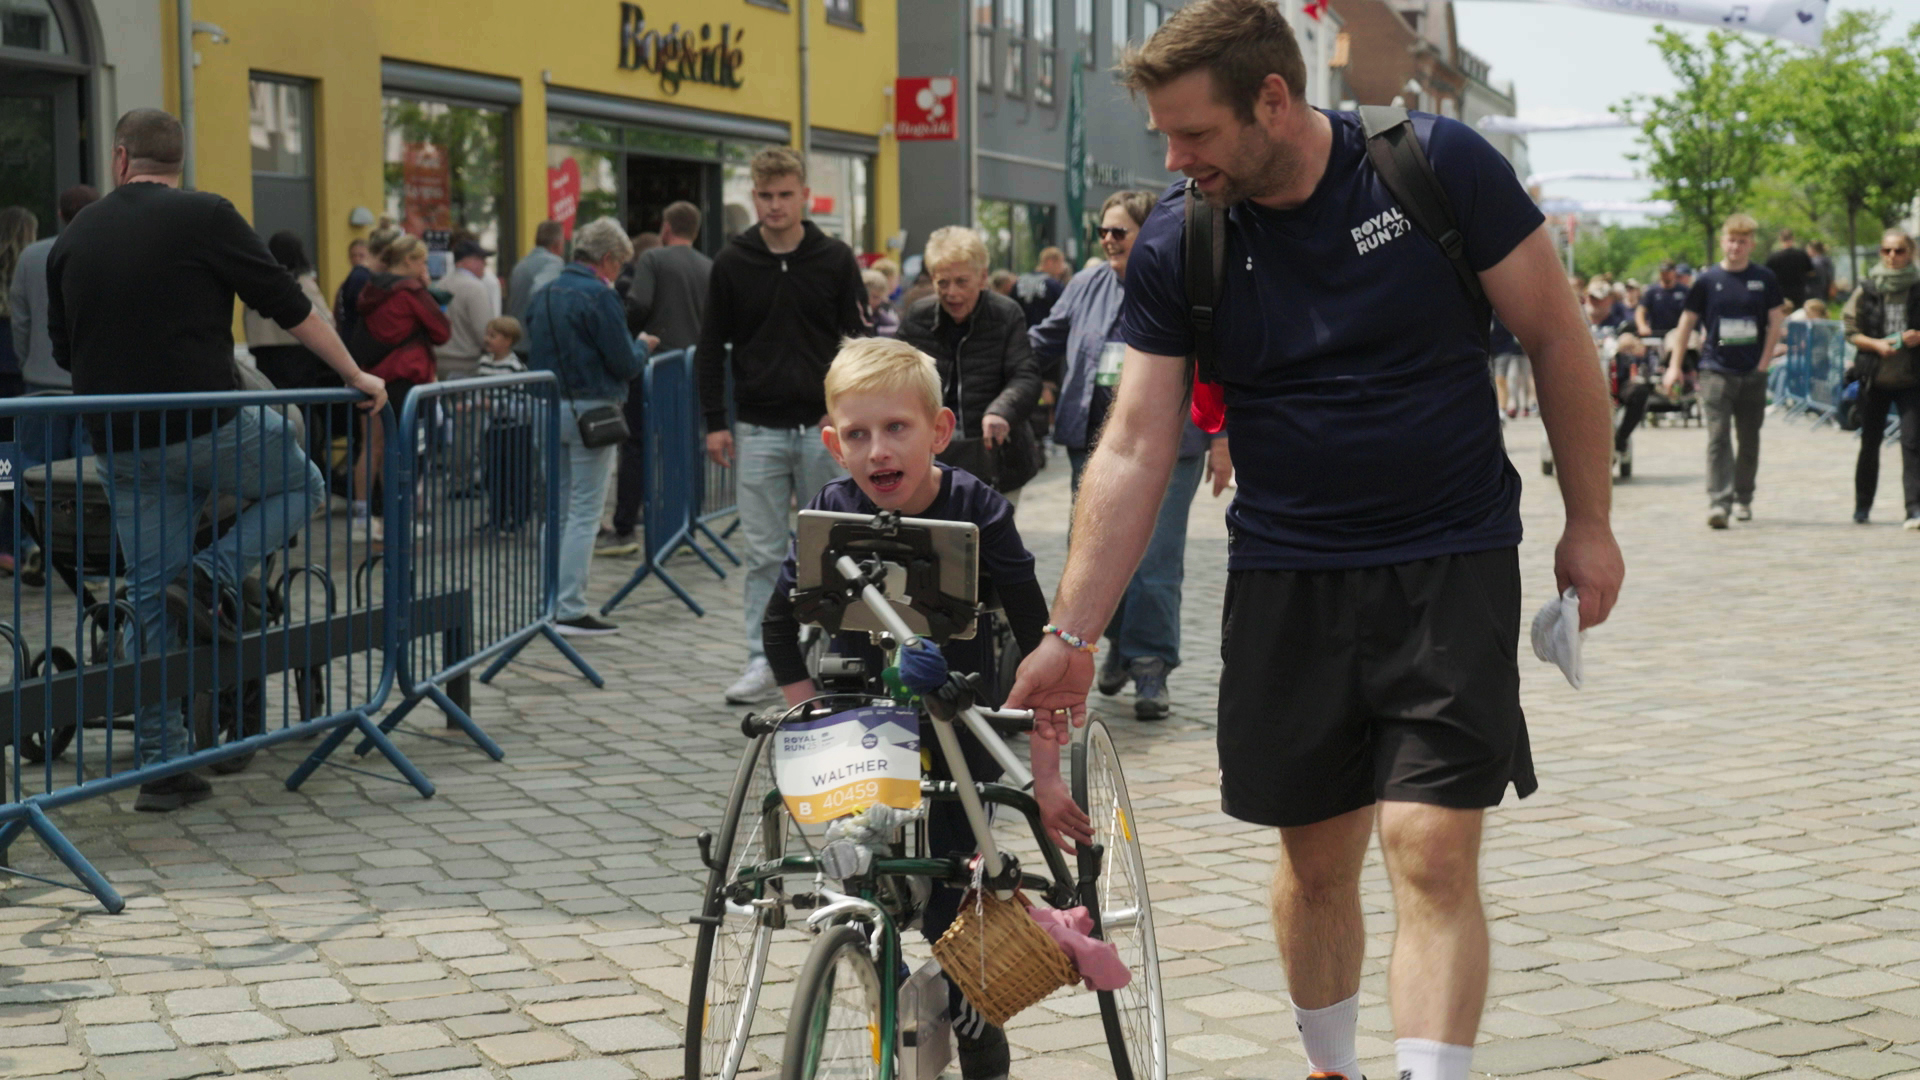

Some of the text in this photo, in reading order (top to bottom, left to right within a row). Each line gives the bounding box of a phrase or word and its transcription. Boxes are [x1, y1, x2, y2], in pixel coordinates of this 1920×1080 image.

[619, 2, 744, 96] Bog&idé
[1351, 207, 1404, 242] ROYAL
[1356, 227, 1392, 255] RUN
[784, 735, 817, 744] ROYAL
[784, 744, 806, 752] RUN
[812, 759, 889, 787] WALTHER
[799, 801, 813, 815] B
[823, 781, 879, 809] 40459
